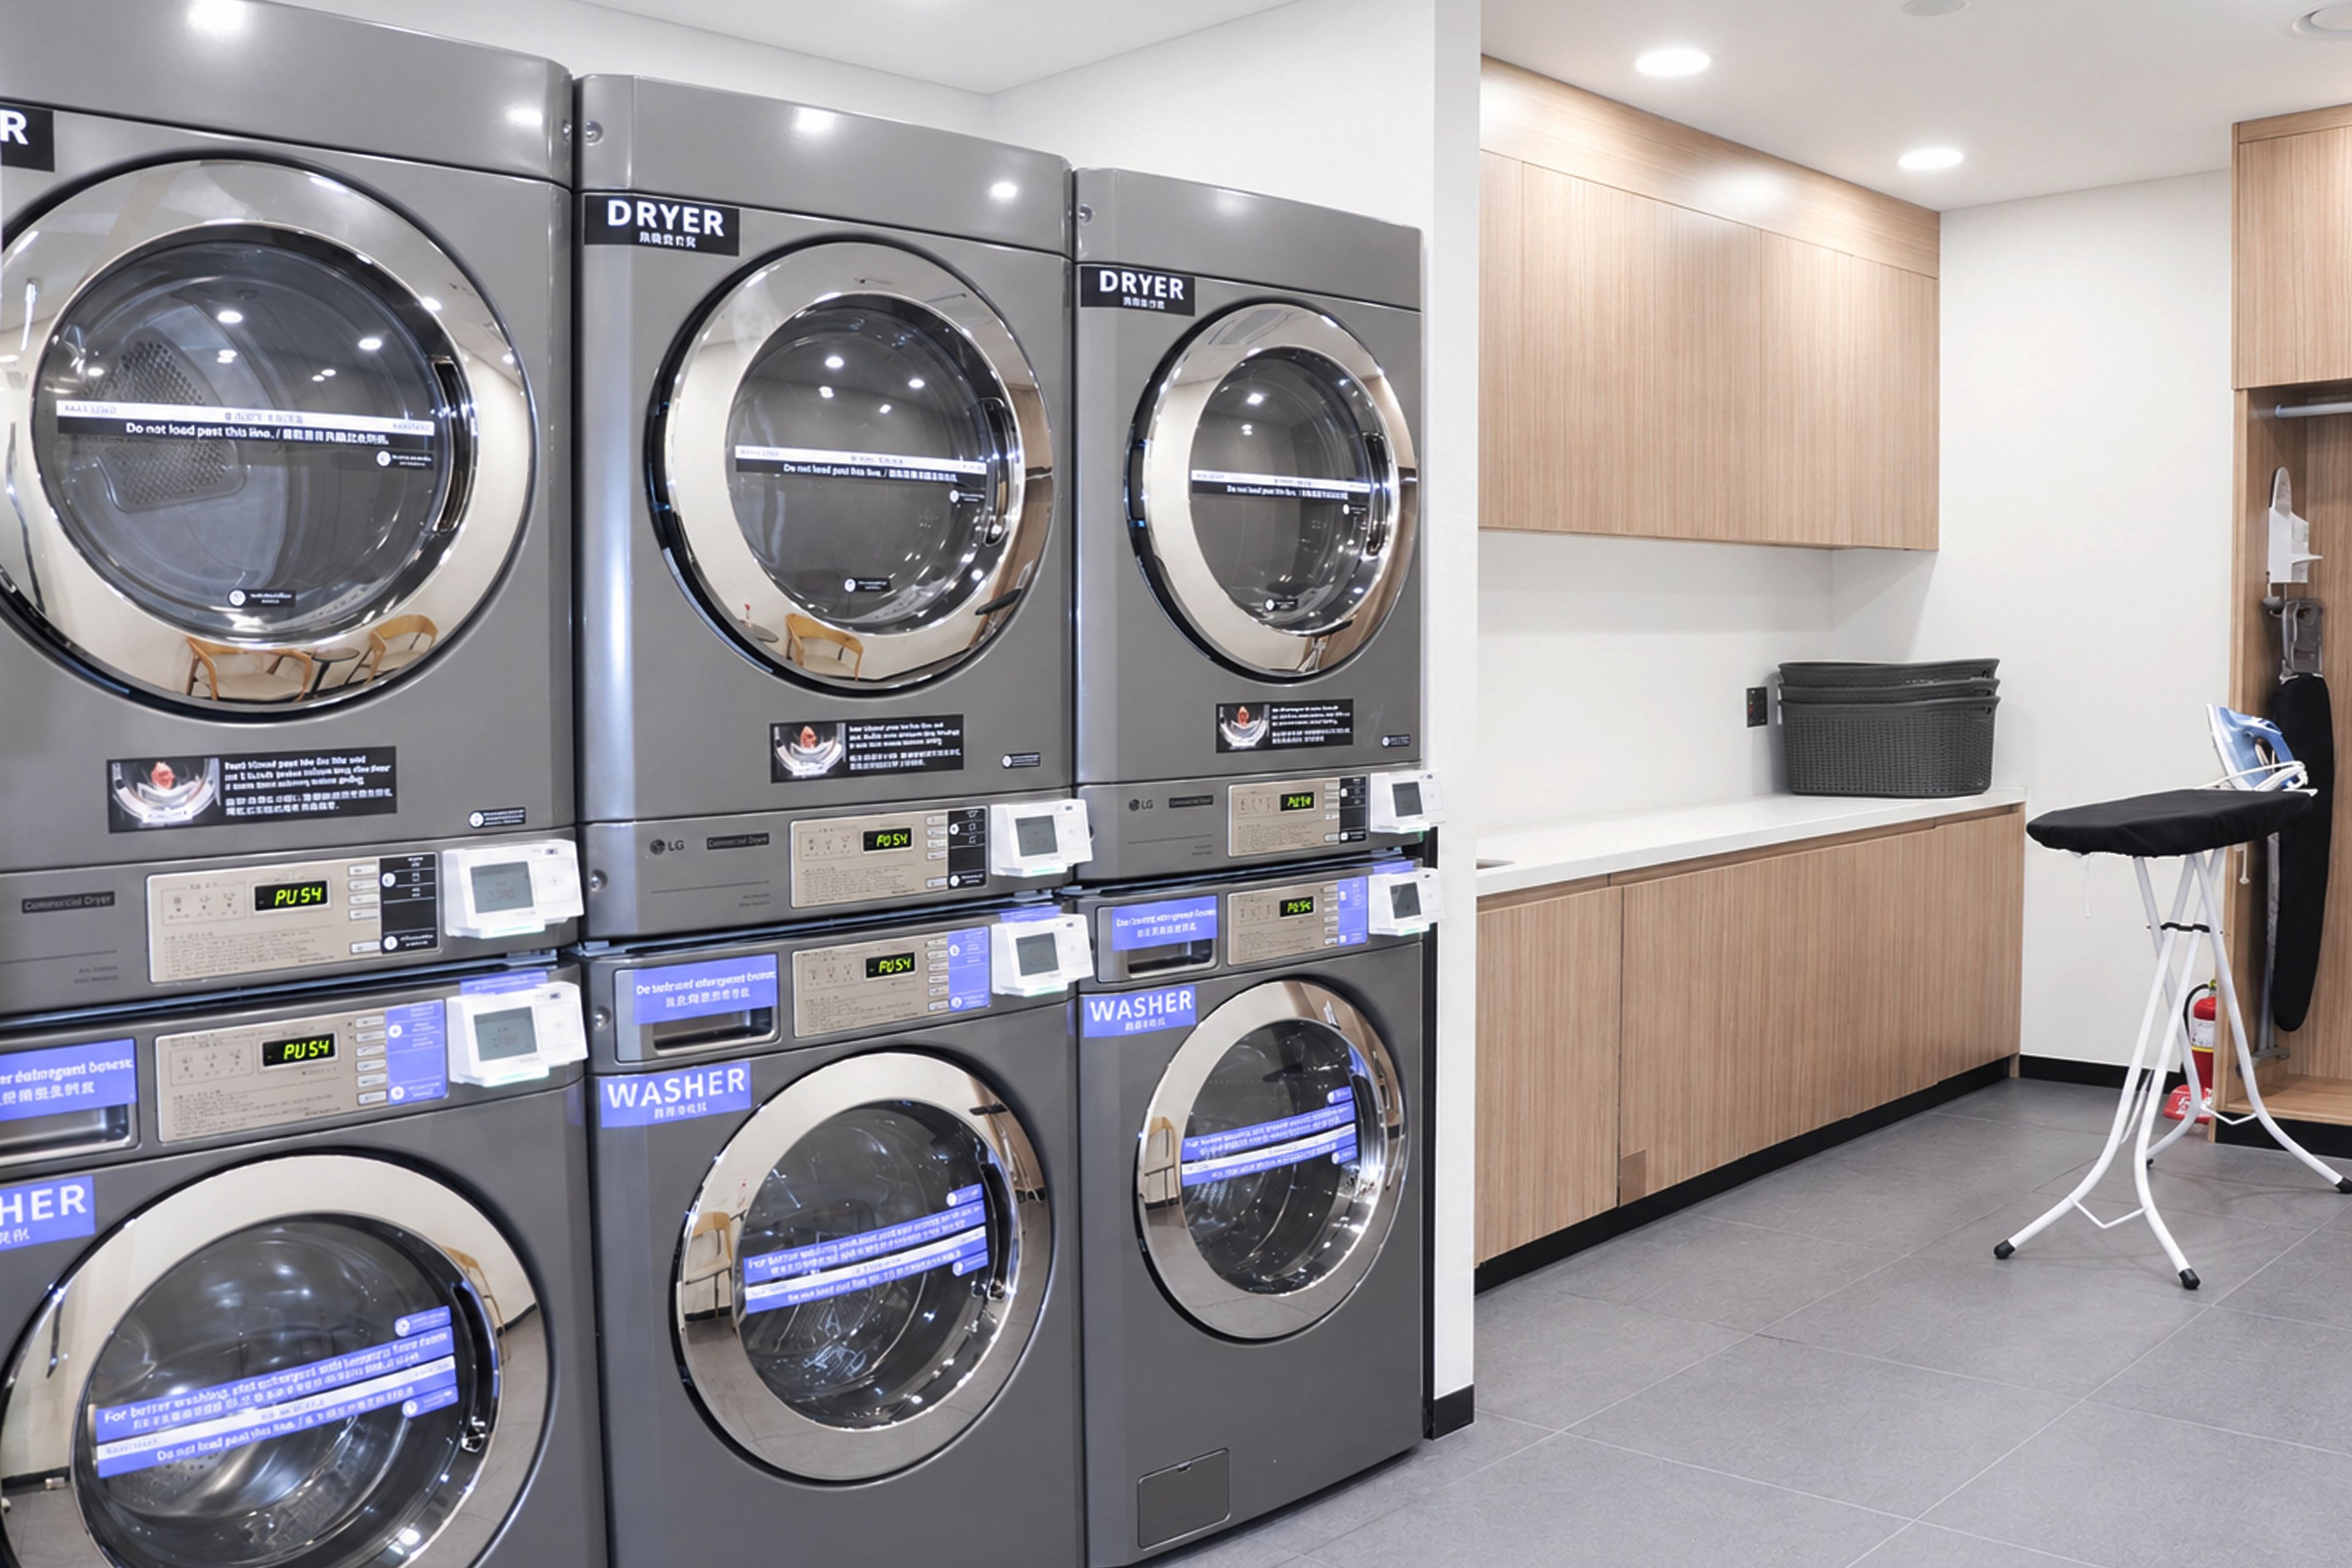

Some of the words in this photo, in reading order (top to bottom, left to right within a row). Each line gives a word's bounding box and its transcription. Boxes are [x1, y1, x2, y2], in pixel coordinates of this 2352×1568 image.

[607, 199, 725, 237] DRYER
[1099, 270, 1185, 300] DRYER
[126, 422, 143, 434] Do
[1142, 799, 1154, 810] LG
[668, 840, 685, 851] LG
[1089, 990, 1193, 1022] WASHER
[606, 1068, 745, 1109] WASHER
[104, 1411, 127, 1424] For
[157, 1447, 174, 1461] Do
